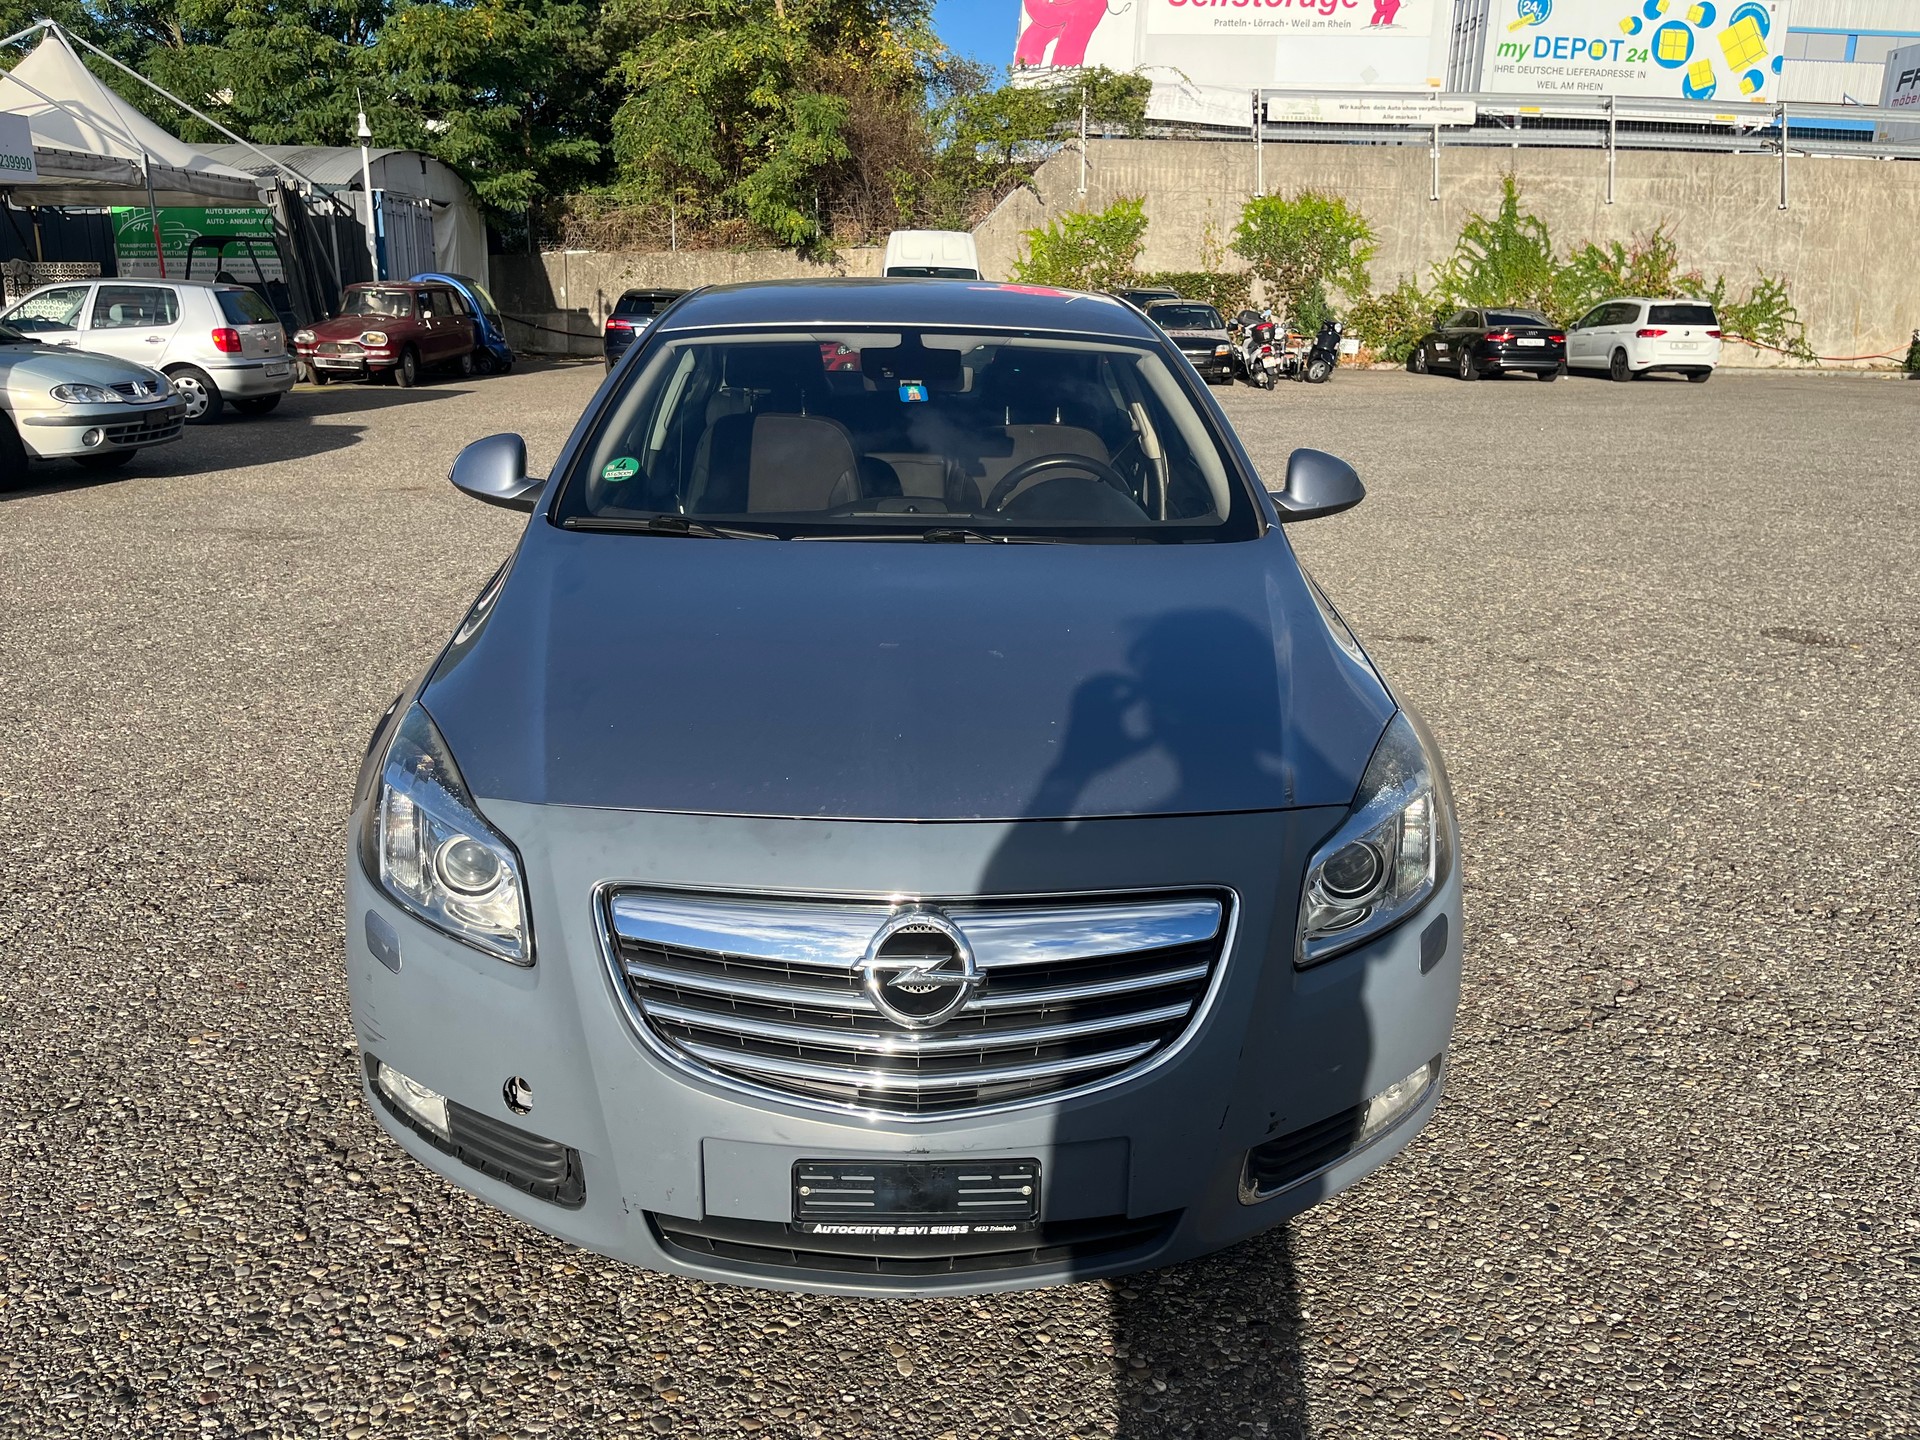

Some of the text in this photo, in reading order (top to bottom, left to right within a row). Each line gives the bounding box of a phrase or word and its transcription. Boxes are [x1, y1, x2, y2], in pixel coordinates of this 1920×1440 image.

[1214, 19, 1247, 28] Pratteln
[1254, 19, 1284, 28] Lörrach
[1292, 20, 1310, 28] Weil
[1328, 20, 1352, 28] Rhein
[1494, 65, 1515, 74] IHRE
[1518, 66, 1564, 76] DEUTSCHE
[1566, 68, 1634, 78] LIEFERADRESSE
[1537, 81, 1604, 91] WEIL AM RHEIN
